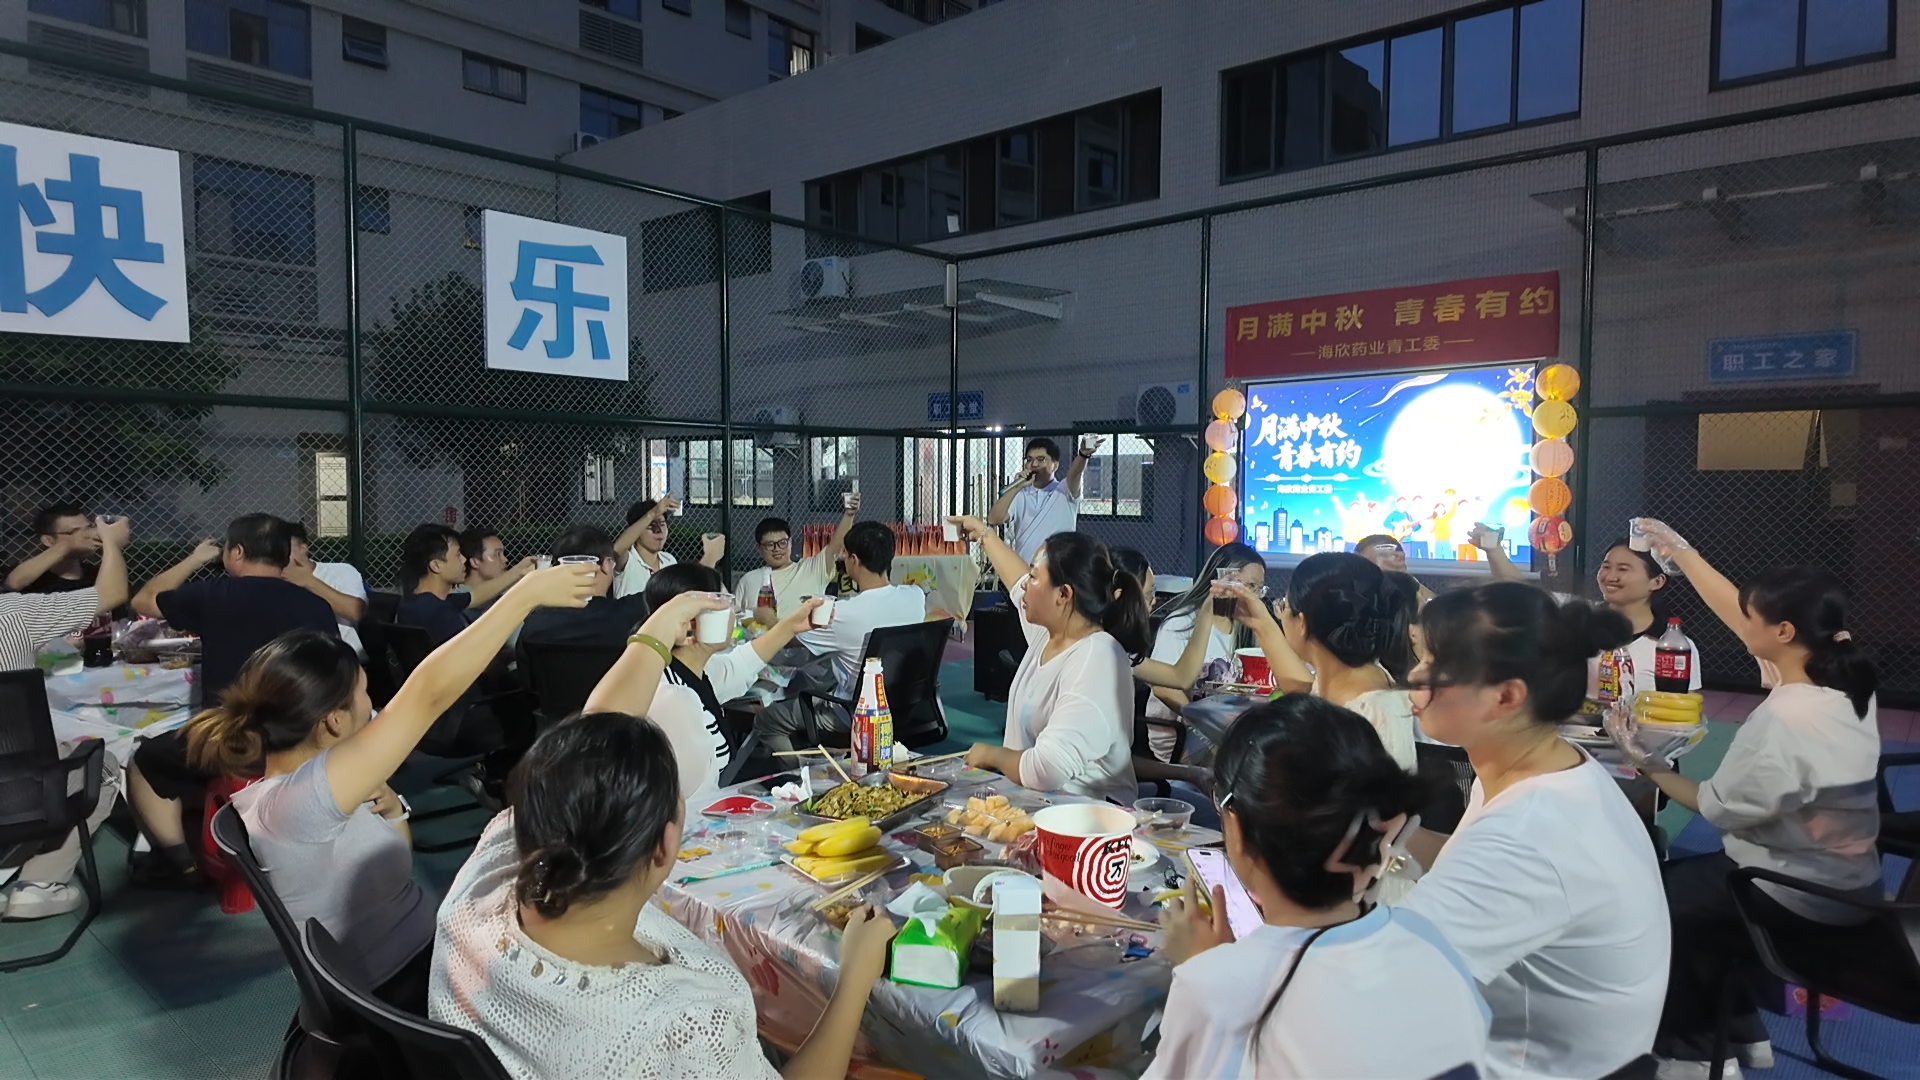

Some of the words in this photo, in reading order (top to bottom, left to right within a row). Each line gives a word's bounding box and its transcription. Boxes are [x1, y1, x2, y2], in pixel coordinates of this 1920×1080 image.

[0, 144, 168, 322] 快
[507, 239, 611, 361] 乐
[1236, 304, 1365, 342] 月满中秋
[1393, 286, 1555, 326] 青春有约
[1318, 335, 1441, 359] 海欣药业青工委
[1723, 348, 1838, 372] 职工之家
[1250, 412, 1349, 447] 月满中秋
[1271, 438, 1362, 472] 青春有约
